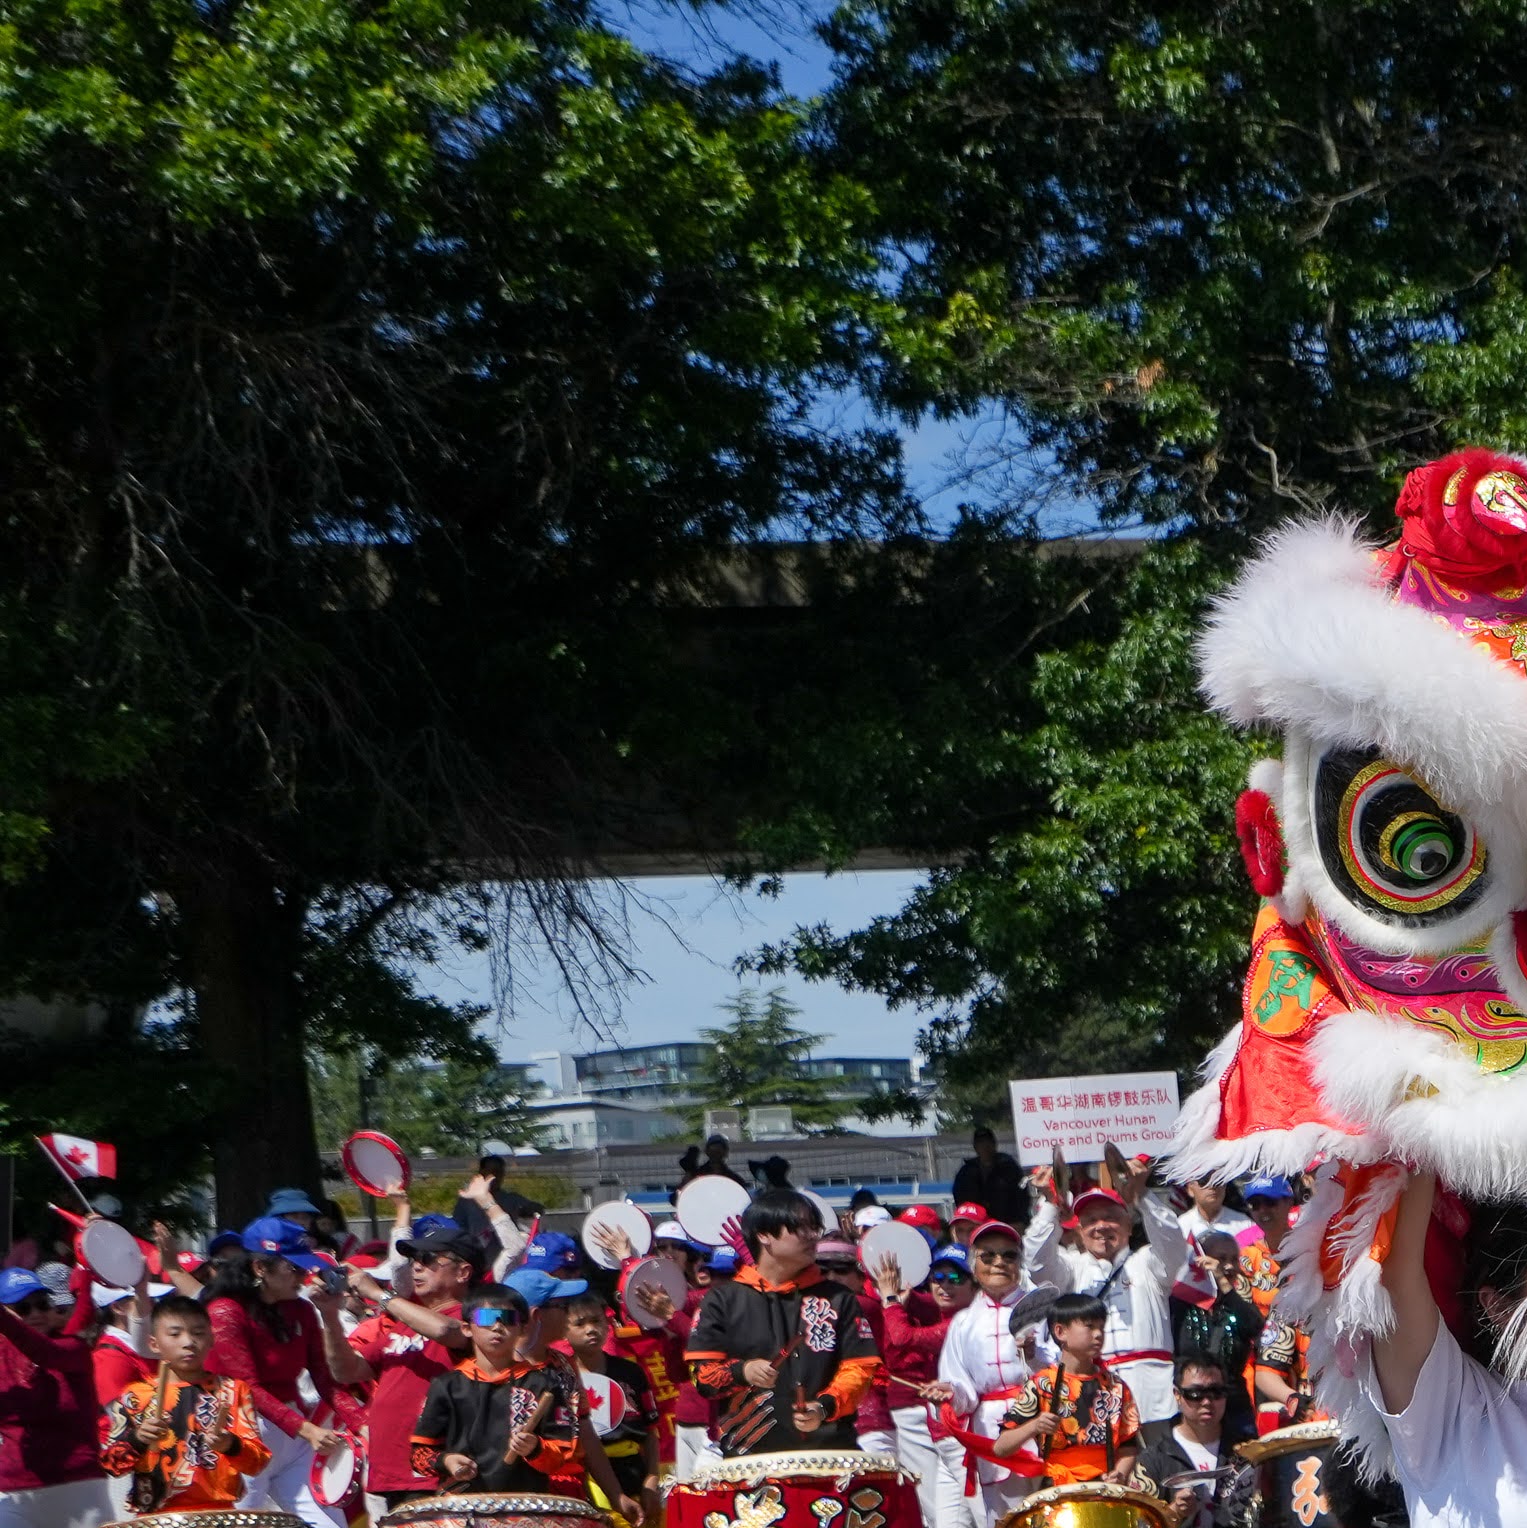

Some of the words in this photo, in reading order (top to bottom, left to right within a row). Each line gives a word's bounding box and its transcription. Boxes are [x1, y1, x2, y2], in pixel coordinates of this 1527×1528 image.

[1042, 1117, 1112, 1131] Vancouver
[1115, 1113, 1157, 1128] Hunan
[1068, 1133, 1093, 1146] and
[1096, 1131, 1138, 1144] Drums
